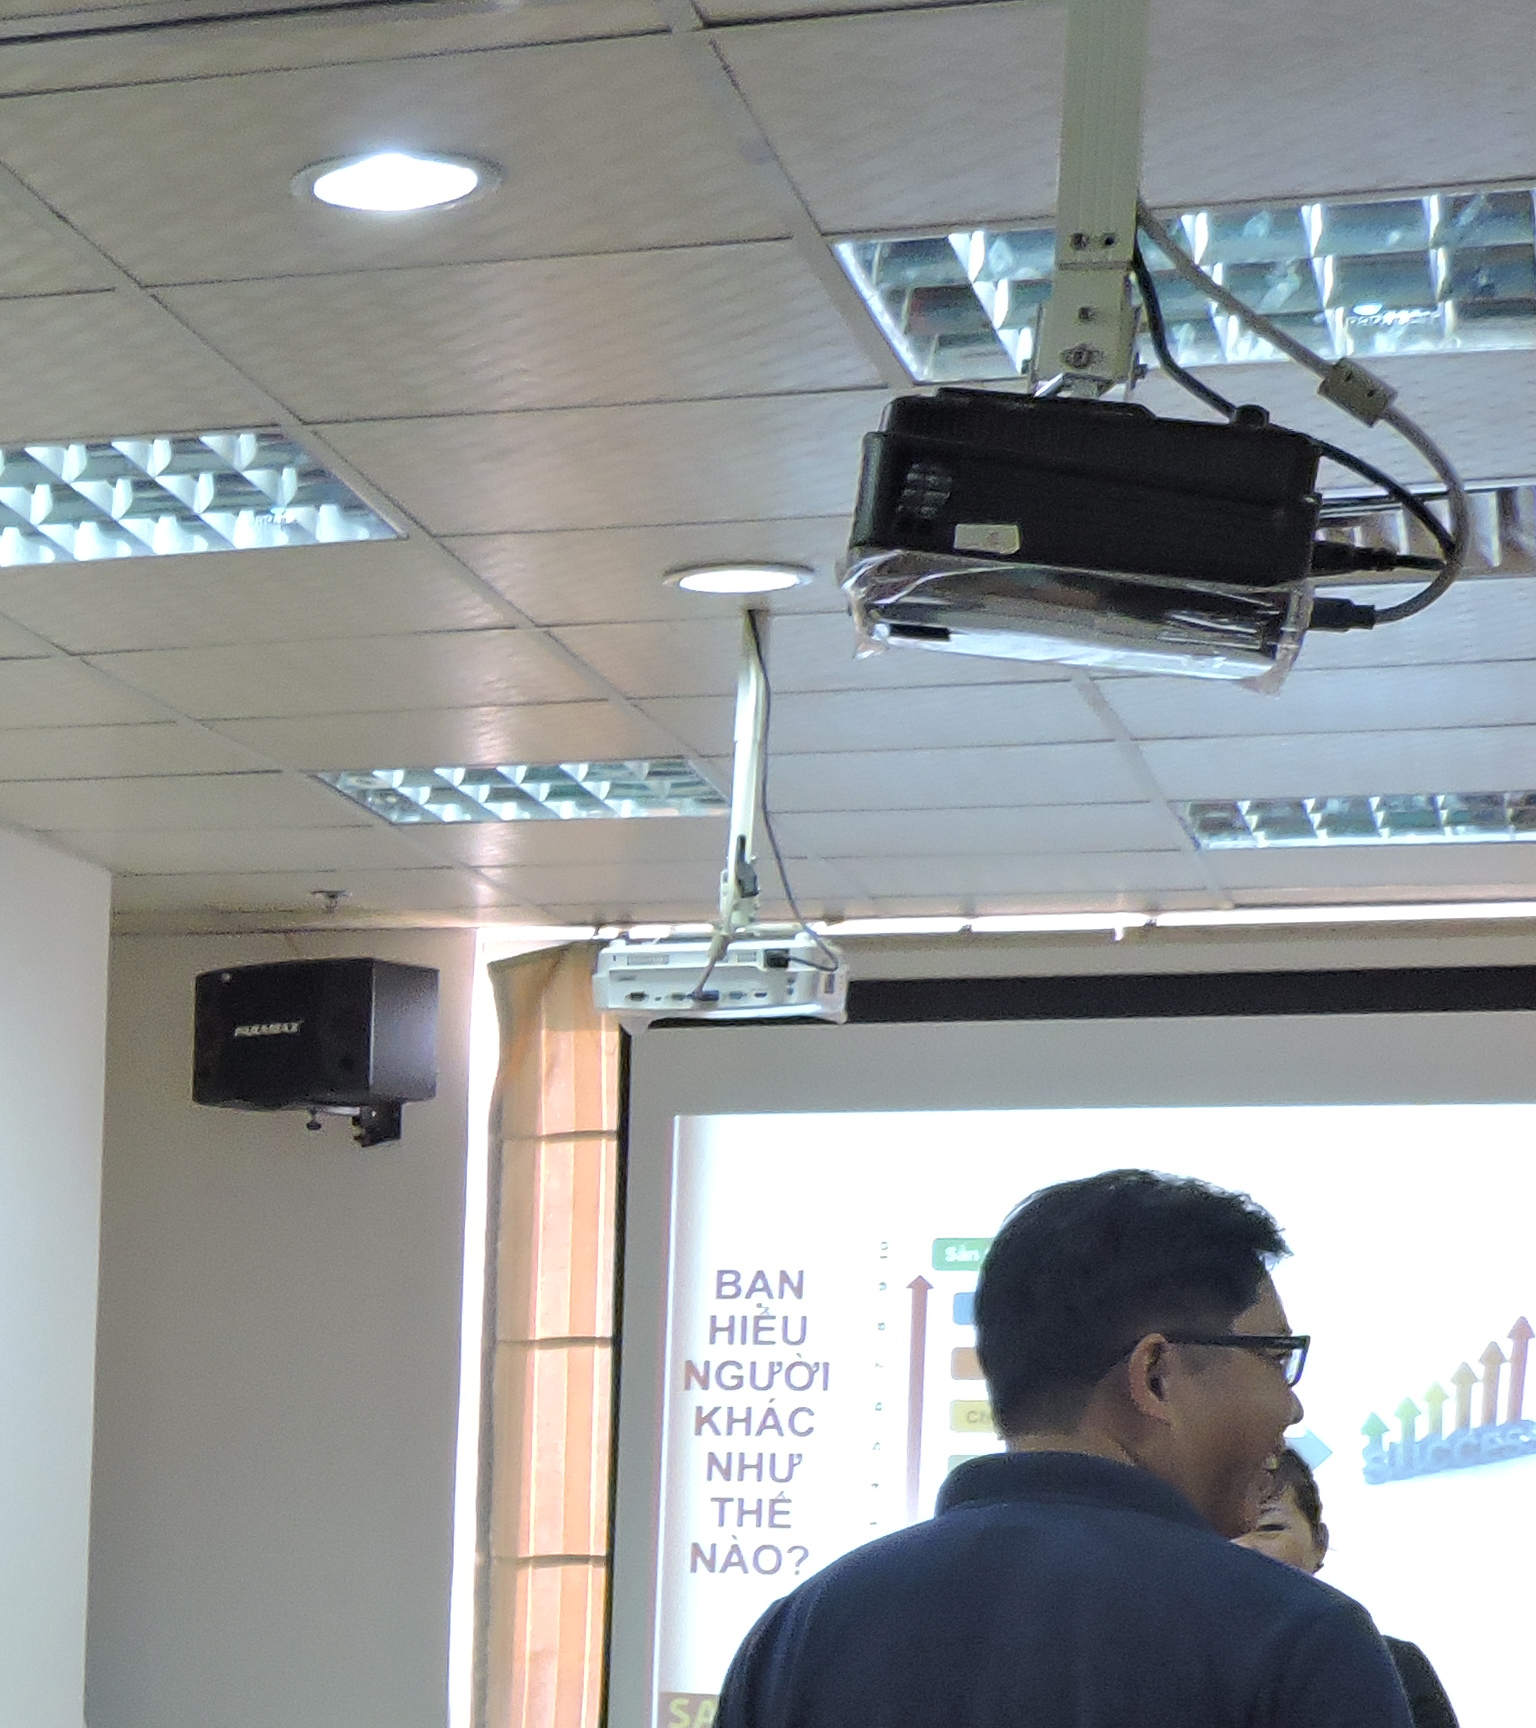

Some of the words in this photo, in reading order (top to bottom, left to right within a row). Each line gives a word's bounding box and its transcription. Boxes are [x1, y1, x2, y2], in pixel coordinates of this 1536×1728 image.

[716, 1270, 804, 1308] BẠN
[709, 1306, 808, 1346] HIỂU
[684, 1353, 830, 1391] NGƯỜI
[694, 1398, 815, 1438] KHÁC
[706, 1452, 803, 1483] NHƯ
[1362, 1418, 1536, 1485] SUCCES
[710, 1491, 792, 1528] THẾ
[690, 1535, 809, 1575] NÀO?
